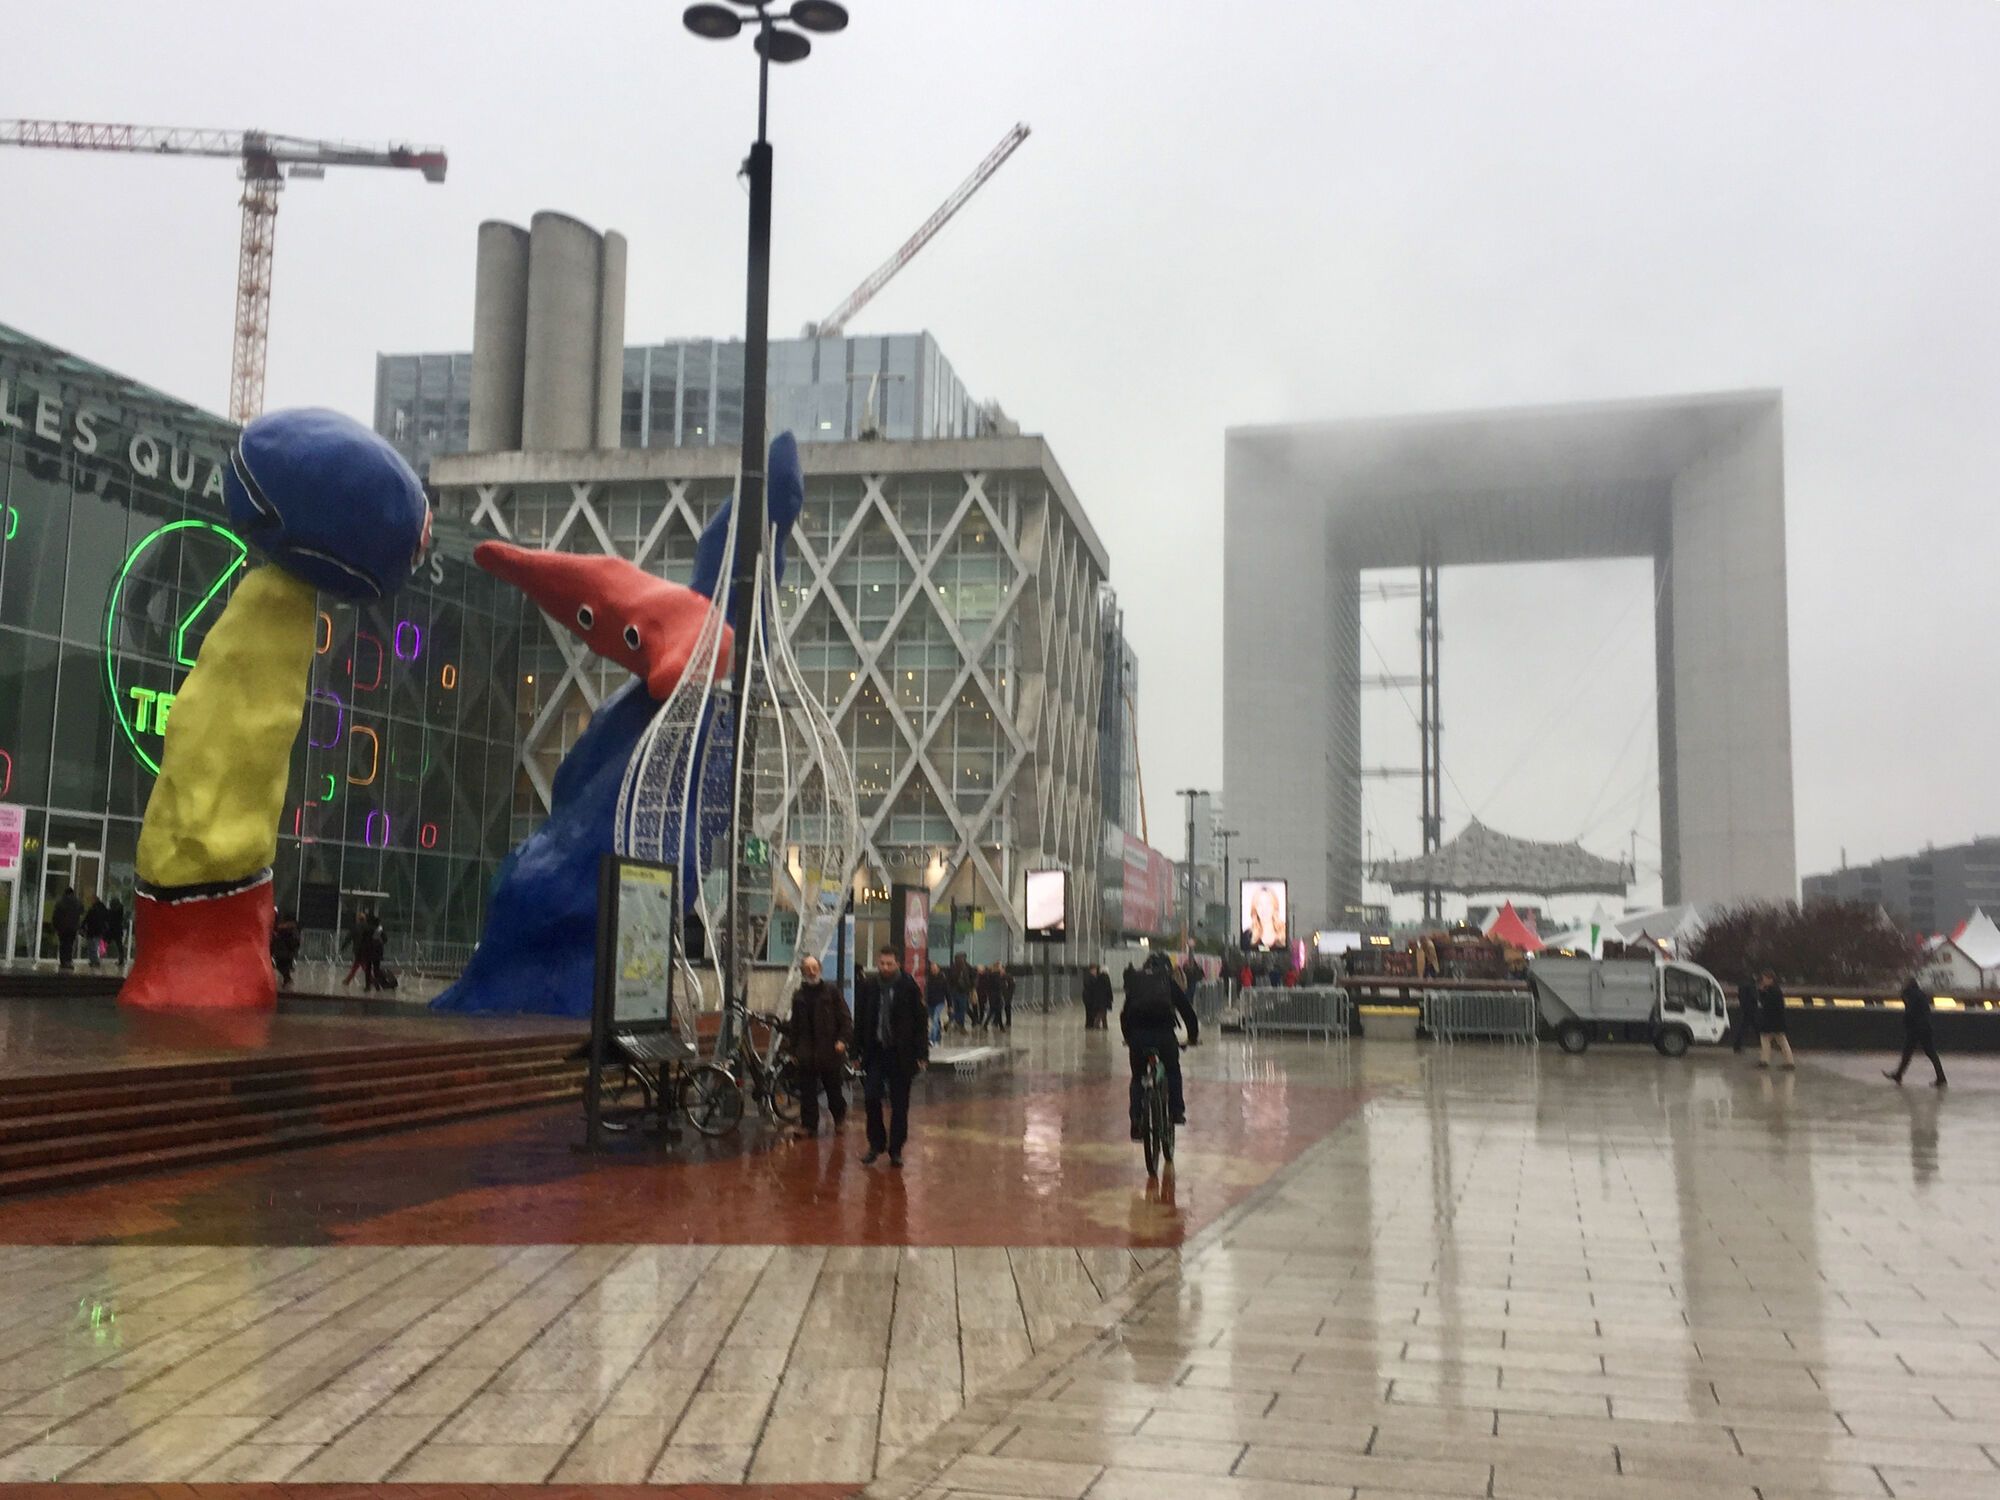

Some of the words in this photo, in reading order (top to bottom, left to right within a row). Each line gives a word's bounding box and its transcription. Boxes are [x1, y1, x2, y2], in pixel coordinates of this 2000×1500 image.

[0, 378, 97, 453] LES
[129, 433, 225, 505] QUA
[130, 686, 177, 736] TE
